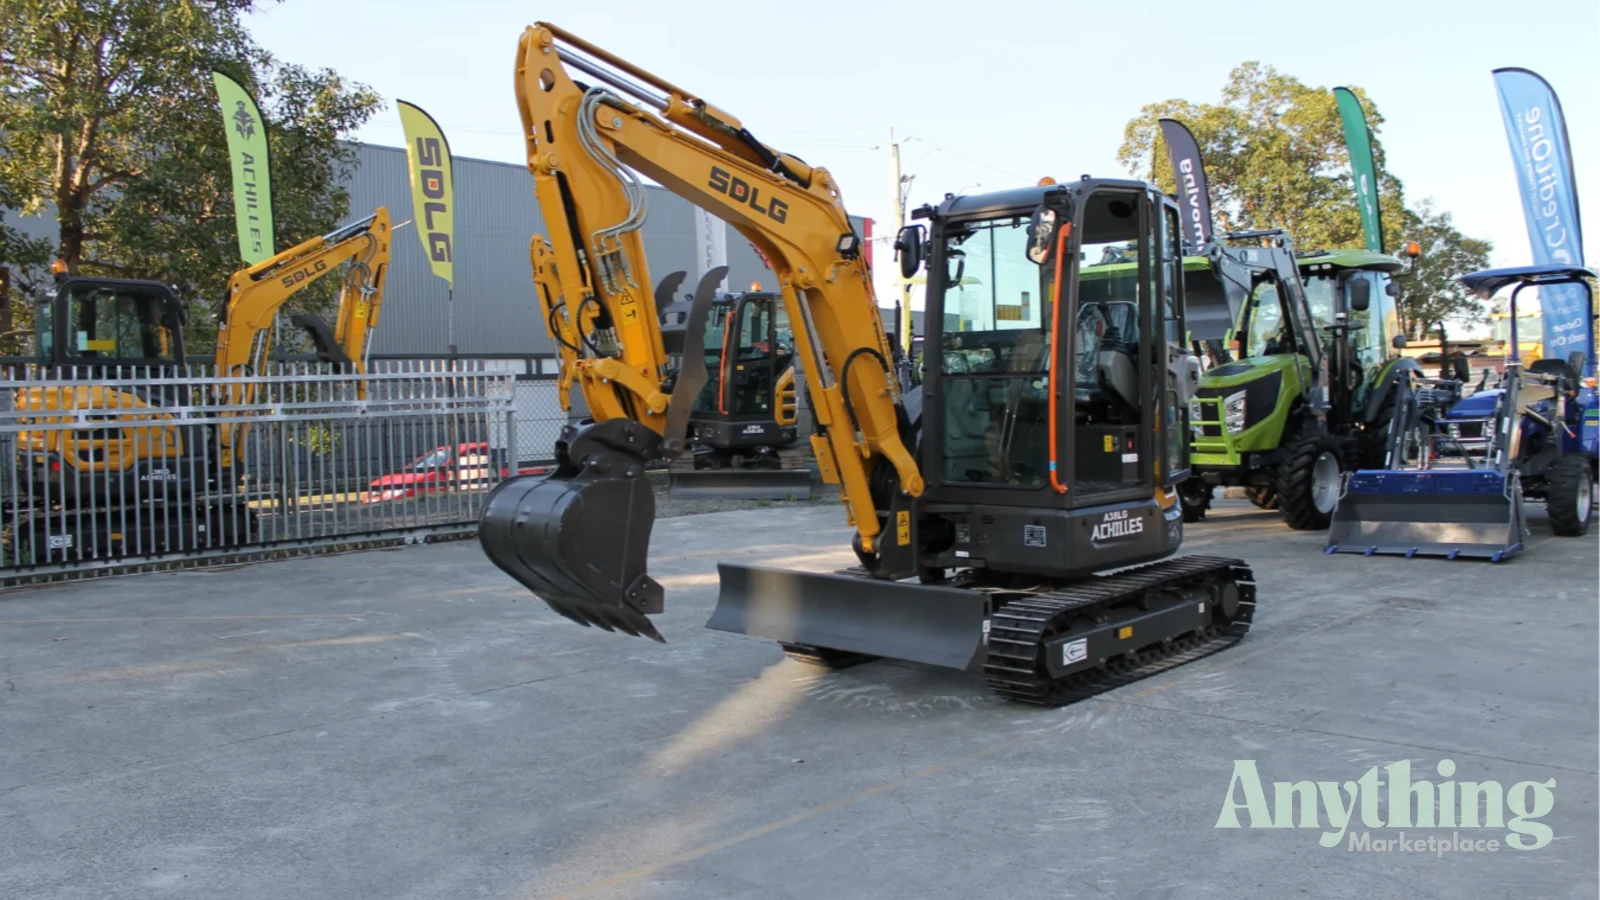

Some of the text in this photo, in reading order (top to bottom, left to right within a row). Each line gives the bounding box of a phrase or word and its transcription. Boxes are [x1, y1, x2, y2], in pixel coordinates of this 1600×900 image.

[241, 152, 262, 254] ACHILLES
[416, 137, 452, 263] SDLG
[708, 165, 789, 224] SDLG
[282, 259, 327, 288] SDLG
[1090, 516, 1144, 541] ACHILLES
